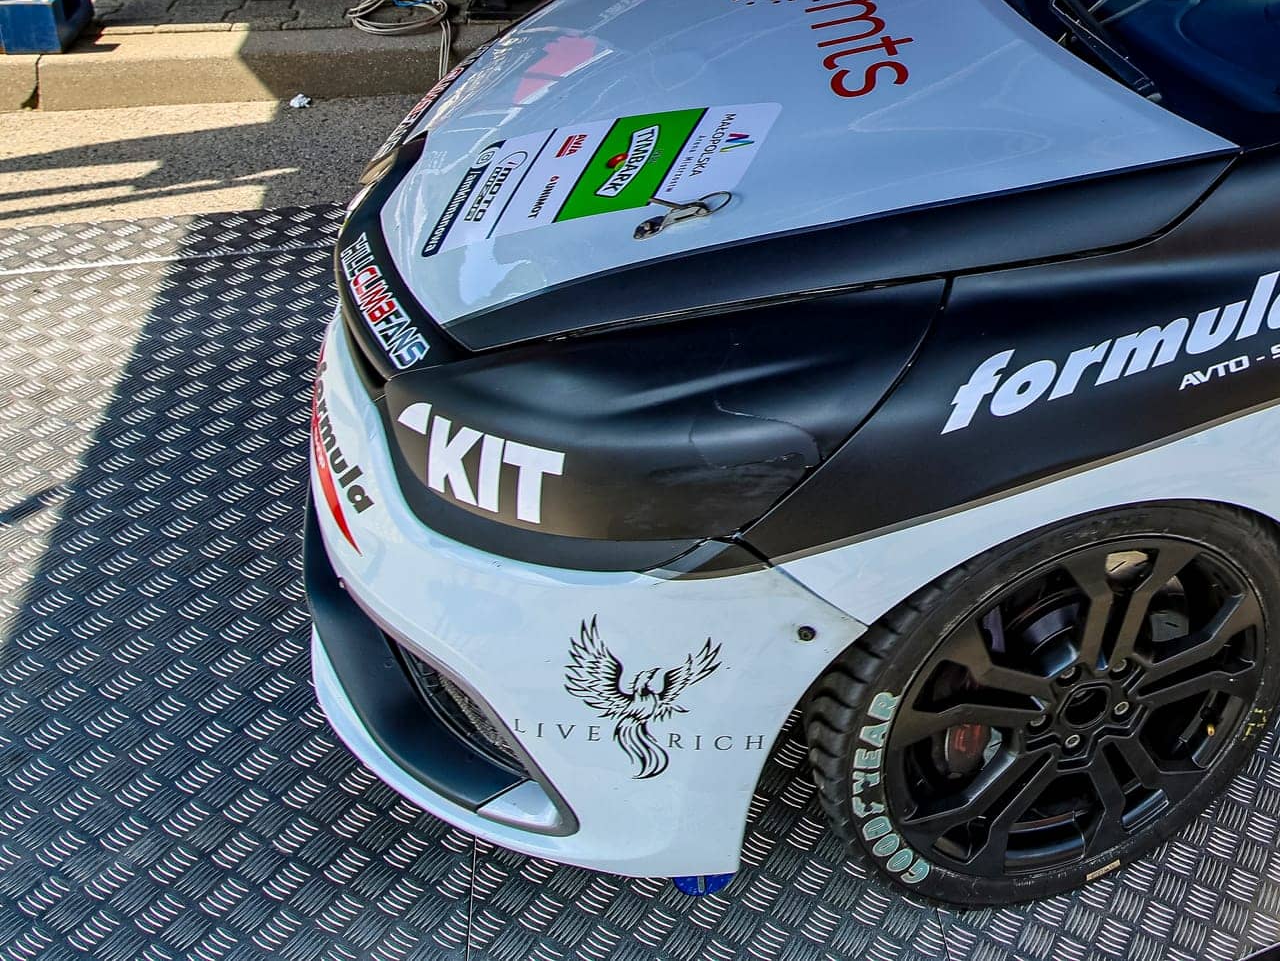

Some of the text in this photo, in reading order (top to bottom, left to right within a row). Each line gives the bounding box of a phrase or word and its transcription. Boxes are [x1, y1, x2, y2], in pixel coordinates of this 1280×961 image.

[603, 127, 656, 192] TYMBARK
[688, 112, 737, 177] MAŁOPOLSKA
[527, 178, 556, 220] UNIMOT
[1178, 355, 1250, 391] AVTO
[427, 414, 566, 524] KIT
[513, 718, 766, 752] LIVE RICH
